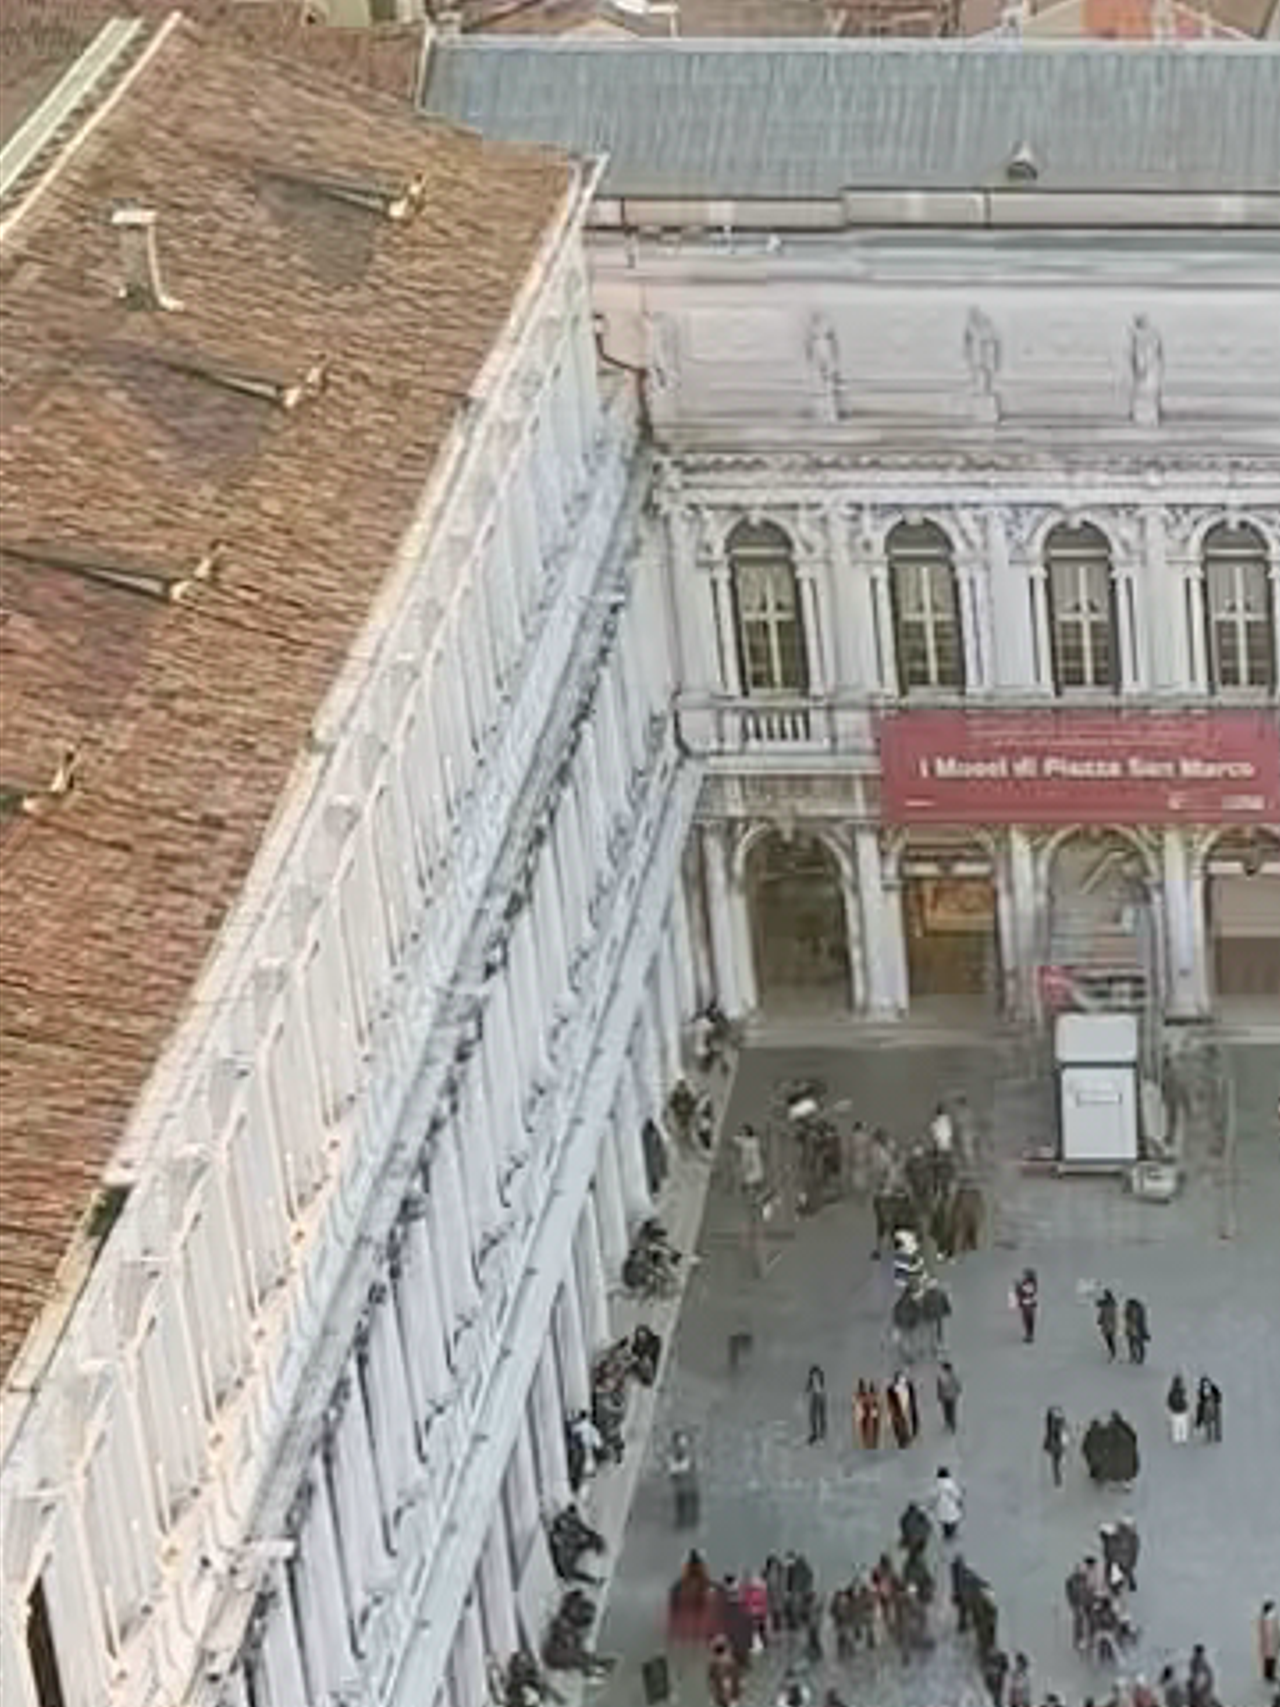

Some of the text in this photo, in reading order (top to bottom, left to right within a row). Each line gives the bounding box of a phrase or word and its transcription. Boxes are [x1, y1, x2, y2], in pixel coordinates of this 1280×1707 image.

[1012, 756, 1037, 779] di
[1044, 756, 1122, 779] Piazza
[1128, 756, 1175, 779] San
[1180, 756, 1255, 780] Marco
